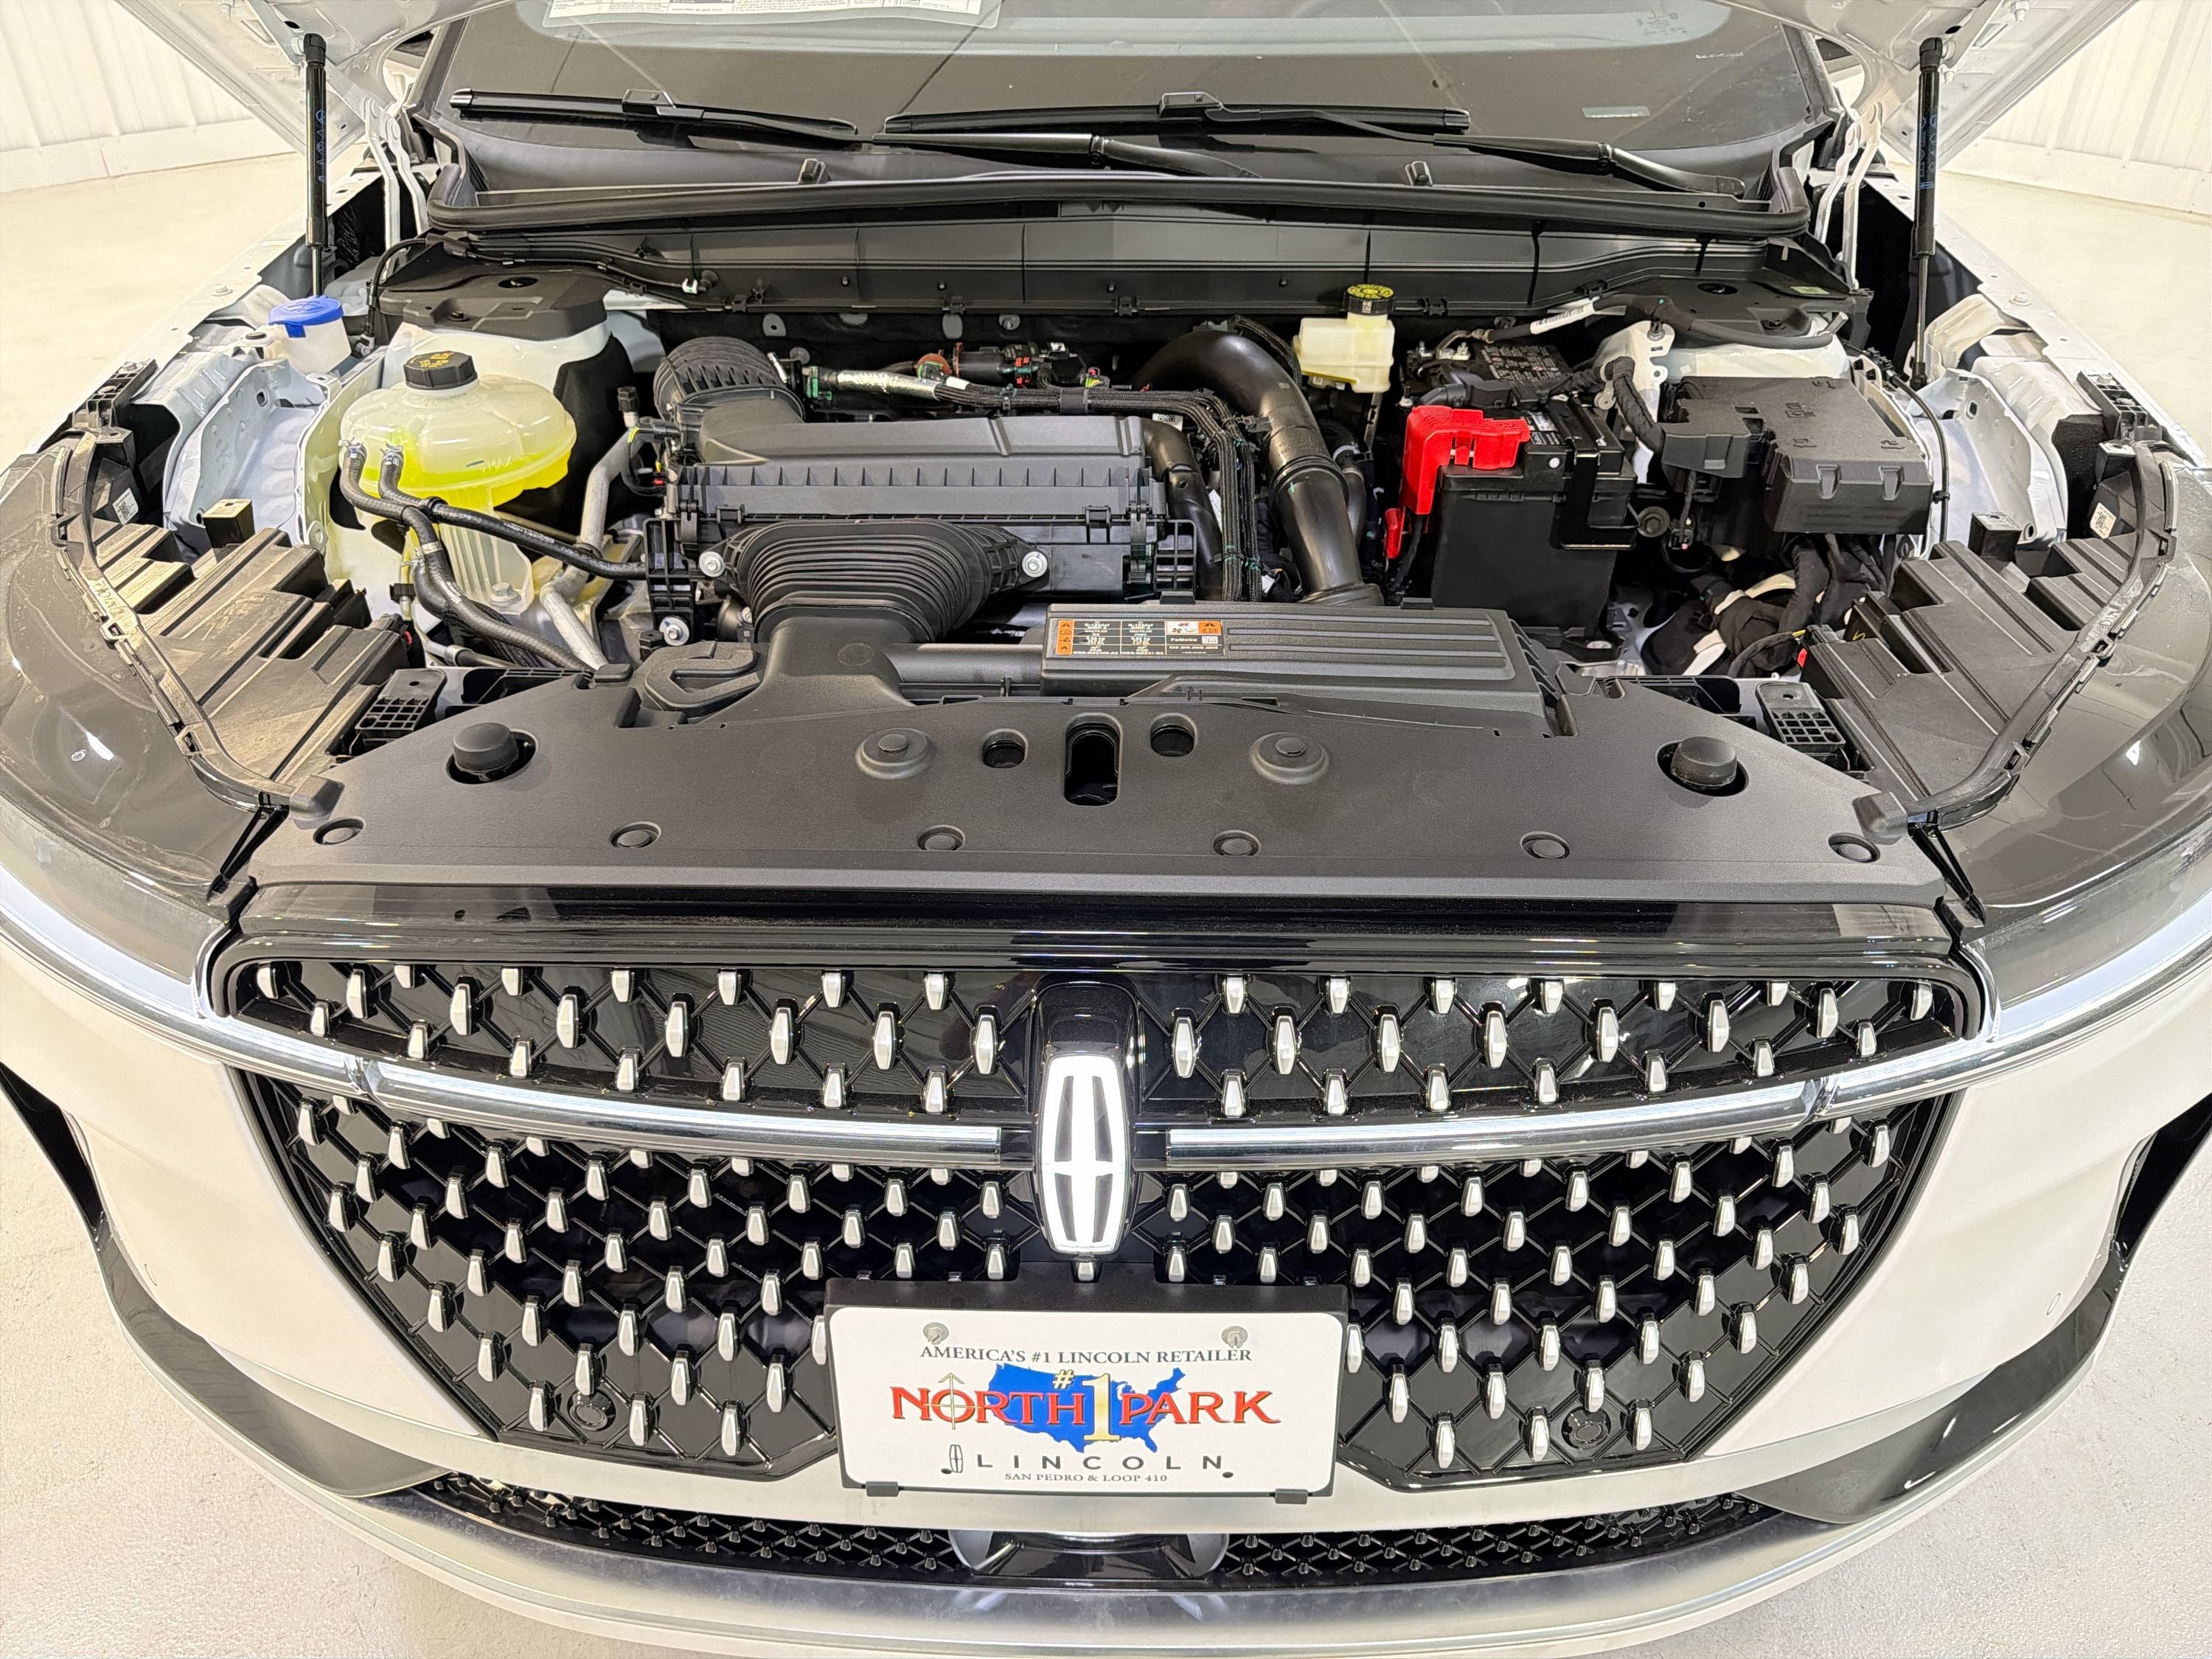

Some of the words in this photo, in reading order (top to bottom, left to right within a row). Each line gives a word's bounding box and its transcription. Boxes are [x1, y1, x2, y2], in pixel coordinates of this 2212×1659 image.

[1032, 1352, 1051, 1363] #1
[1057, 1351, 1150, 1364] LINCOLN
[1156, 1349, 1253, 1363] RETAILER
[890, 1387, 1086, 1426] NORTH
[1119, 1391, 1281, 1425] PARK
[977, 1454, 1222, 1470] LINCOLN
[1005, 1472, 1032, 1481] SAN
[1036, 1473, 1084, 1482] PEDRO
[1088, 1474, 1098, 1482] &
[1102, 1474, 1141, 1482] LOOP
[1144, 1474, 1168, 1482] 410
